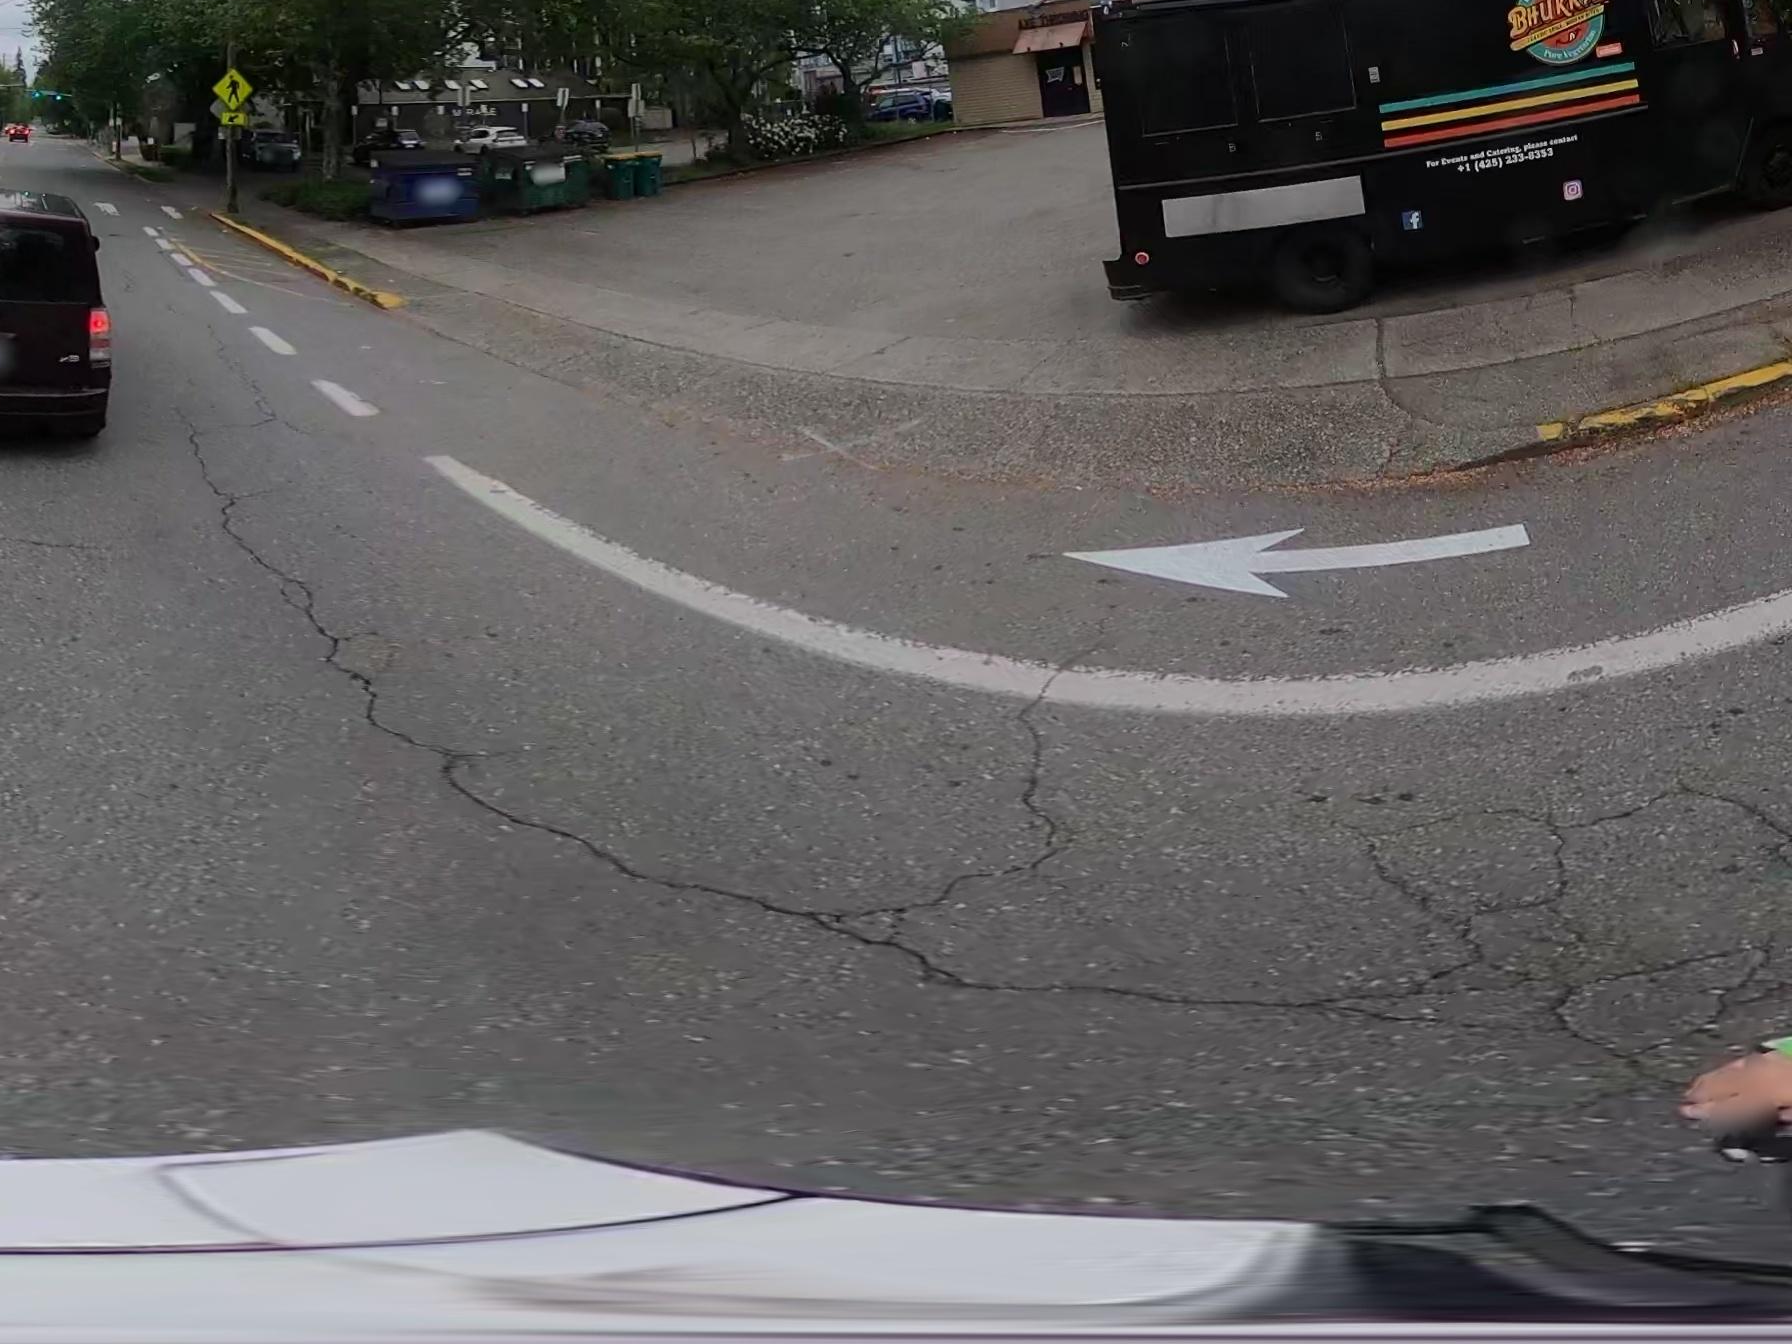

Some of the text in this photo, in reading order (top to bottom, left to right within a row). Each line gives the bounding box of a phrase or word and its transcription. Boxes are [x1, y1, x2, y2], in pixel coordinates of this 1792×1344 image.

[1426, 134, 1578, 168] For Events and Catering, please contact
[1457, 163, 1471, 172] +1
[1474, 156, 1503, 172] (425)
